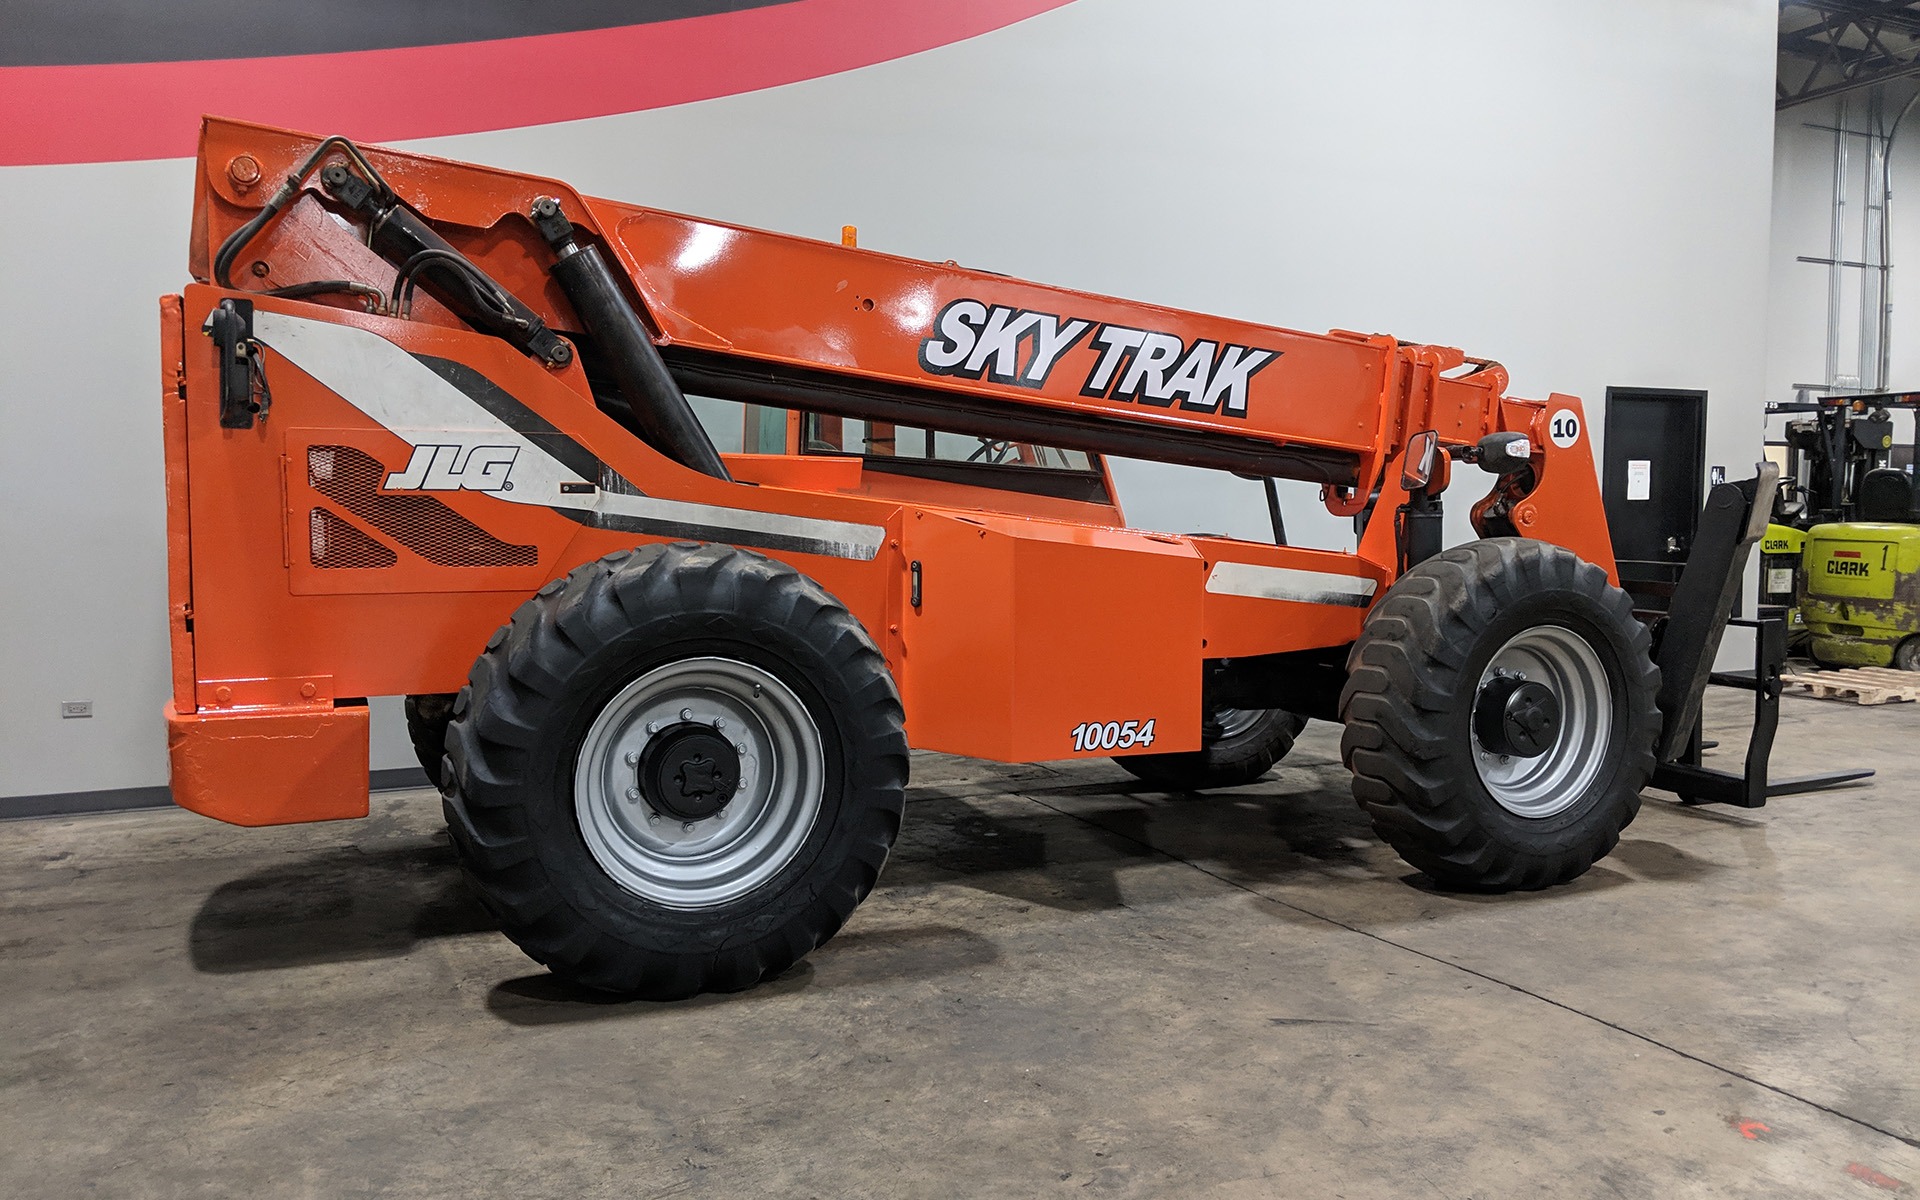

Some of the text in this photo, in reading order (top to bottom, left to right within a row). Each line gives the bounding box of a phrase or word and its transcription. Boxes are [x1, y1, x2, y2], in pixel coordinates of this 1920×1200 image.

[918, 298, 1284, 418] SKY TRAK
[1553, 418, 1577, 438] 10
[382, 444, 521, 491] JLG
[1765, 540, 1788, 549] CLARK
[1827, 560, 1869, 577] CLARK
[1881, 545, 1889, 571] 1
[1071, 719, 1156, 751] 10054
